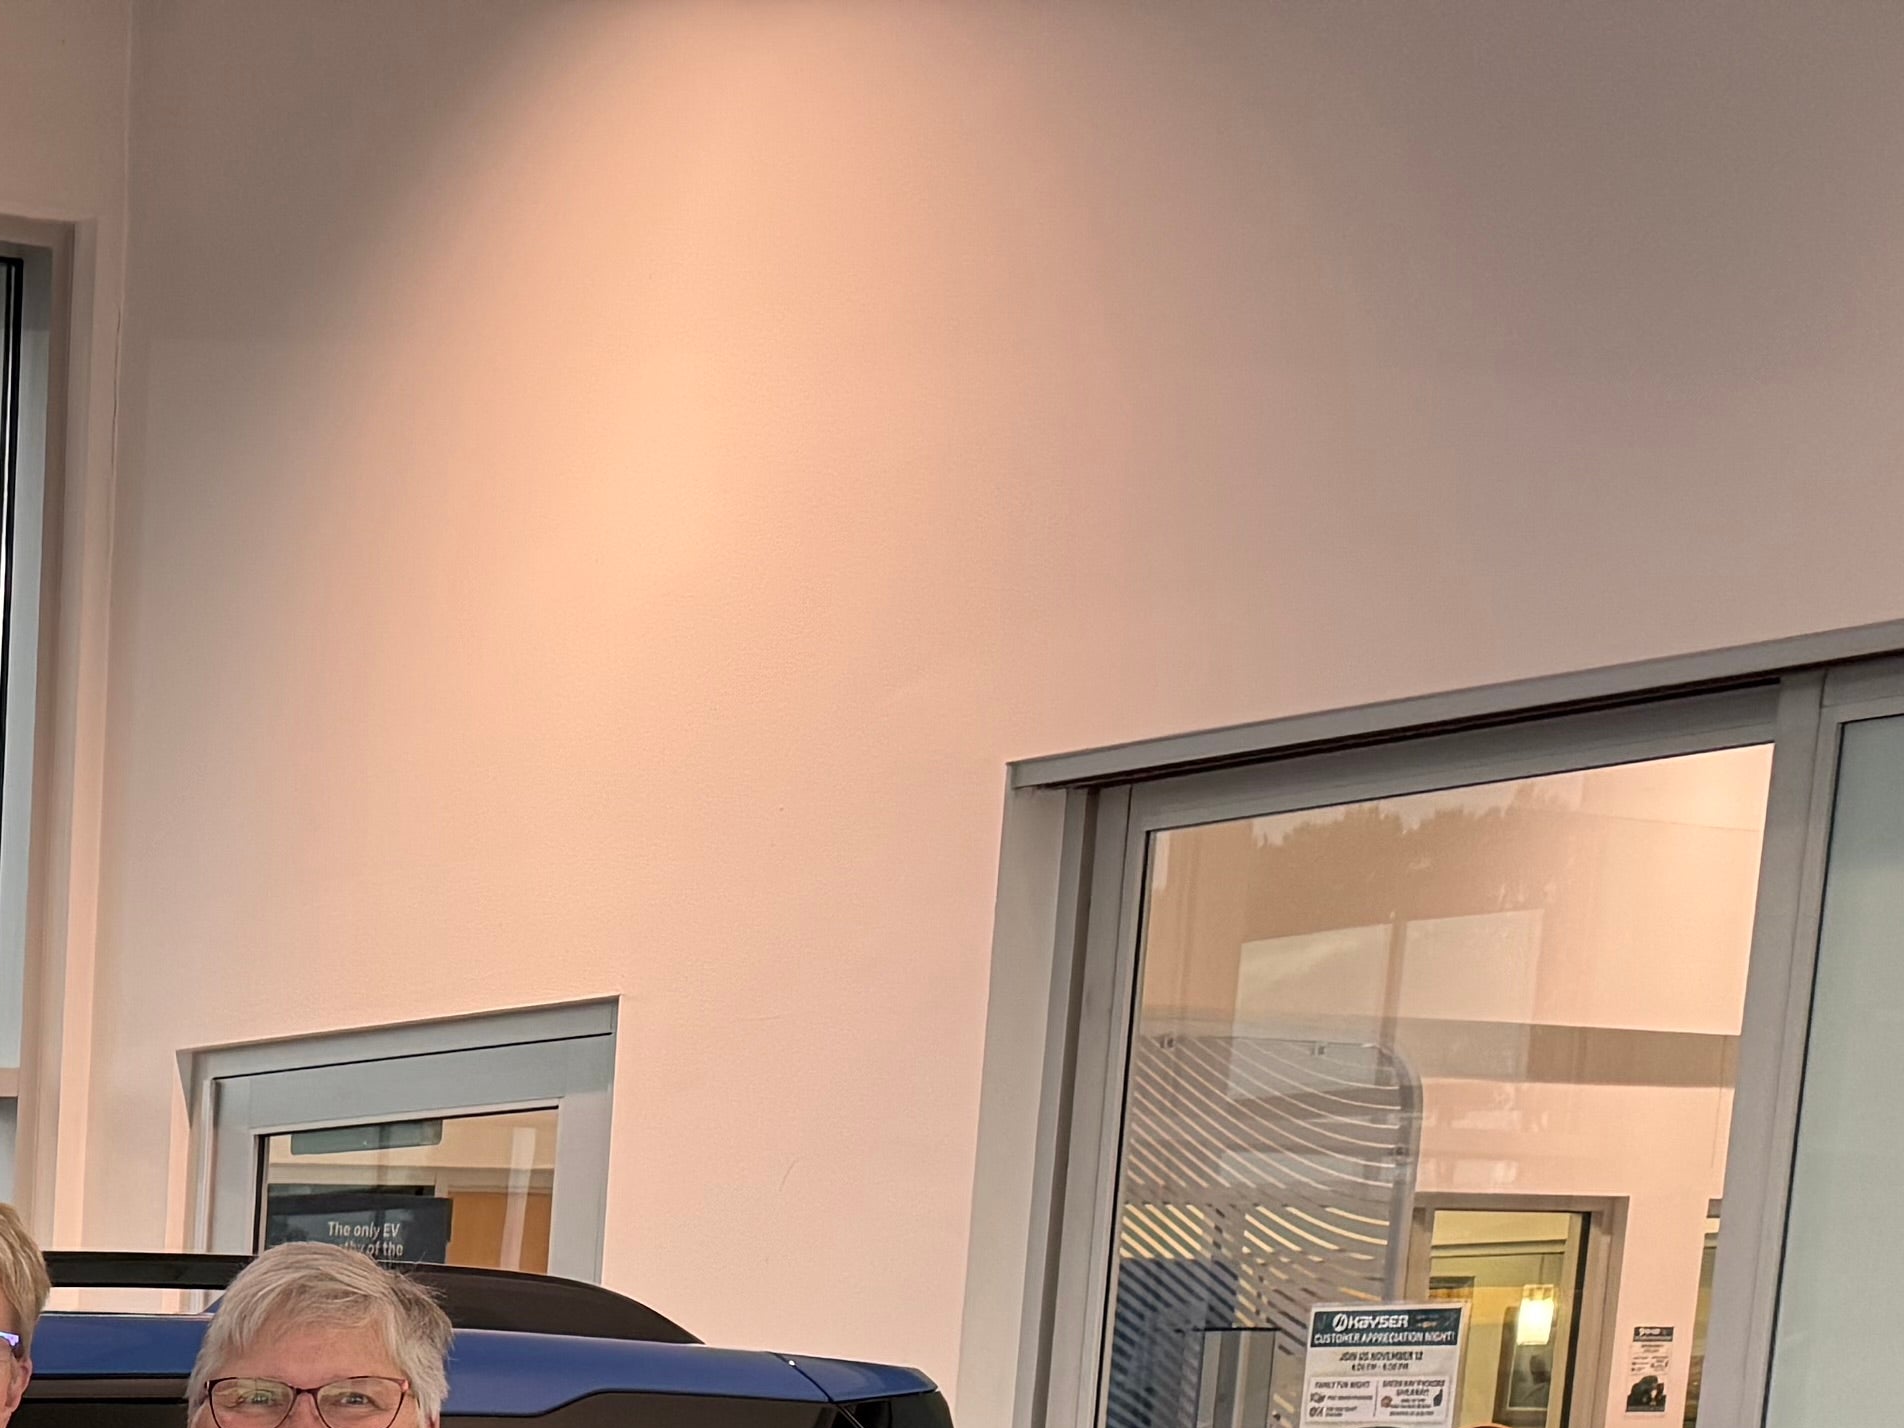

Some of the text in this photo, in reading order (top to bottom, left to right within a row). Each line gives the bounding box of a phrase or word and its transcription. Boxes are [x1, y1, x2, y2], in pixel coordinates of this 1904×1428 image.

[328, 1221, 400, 1240] The only EV
[366, 1242, 381, 1255] of
[383, 1242, 403, 1256] the
[1314, 1333, 1359, 1344] CUSTOMER
